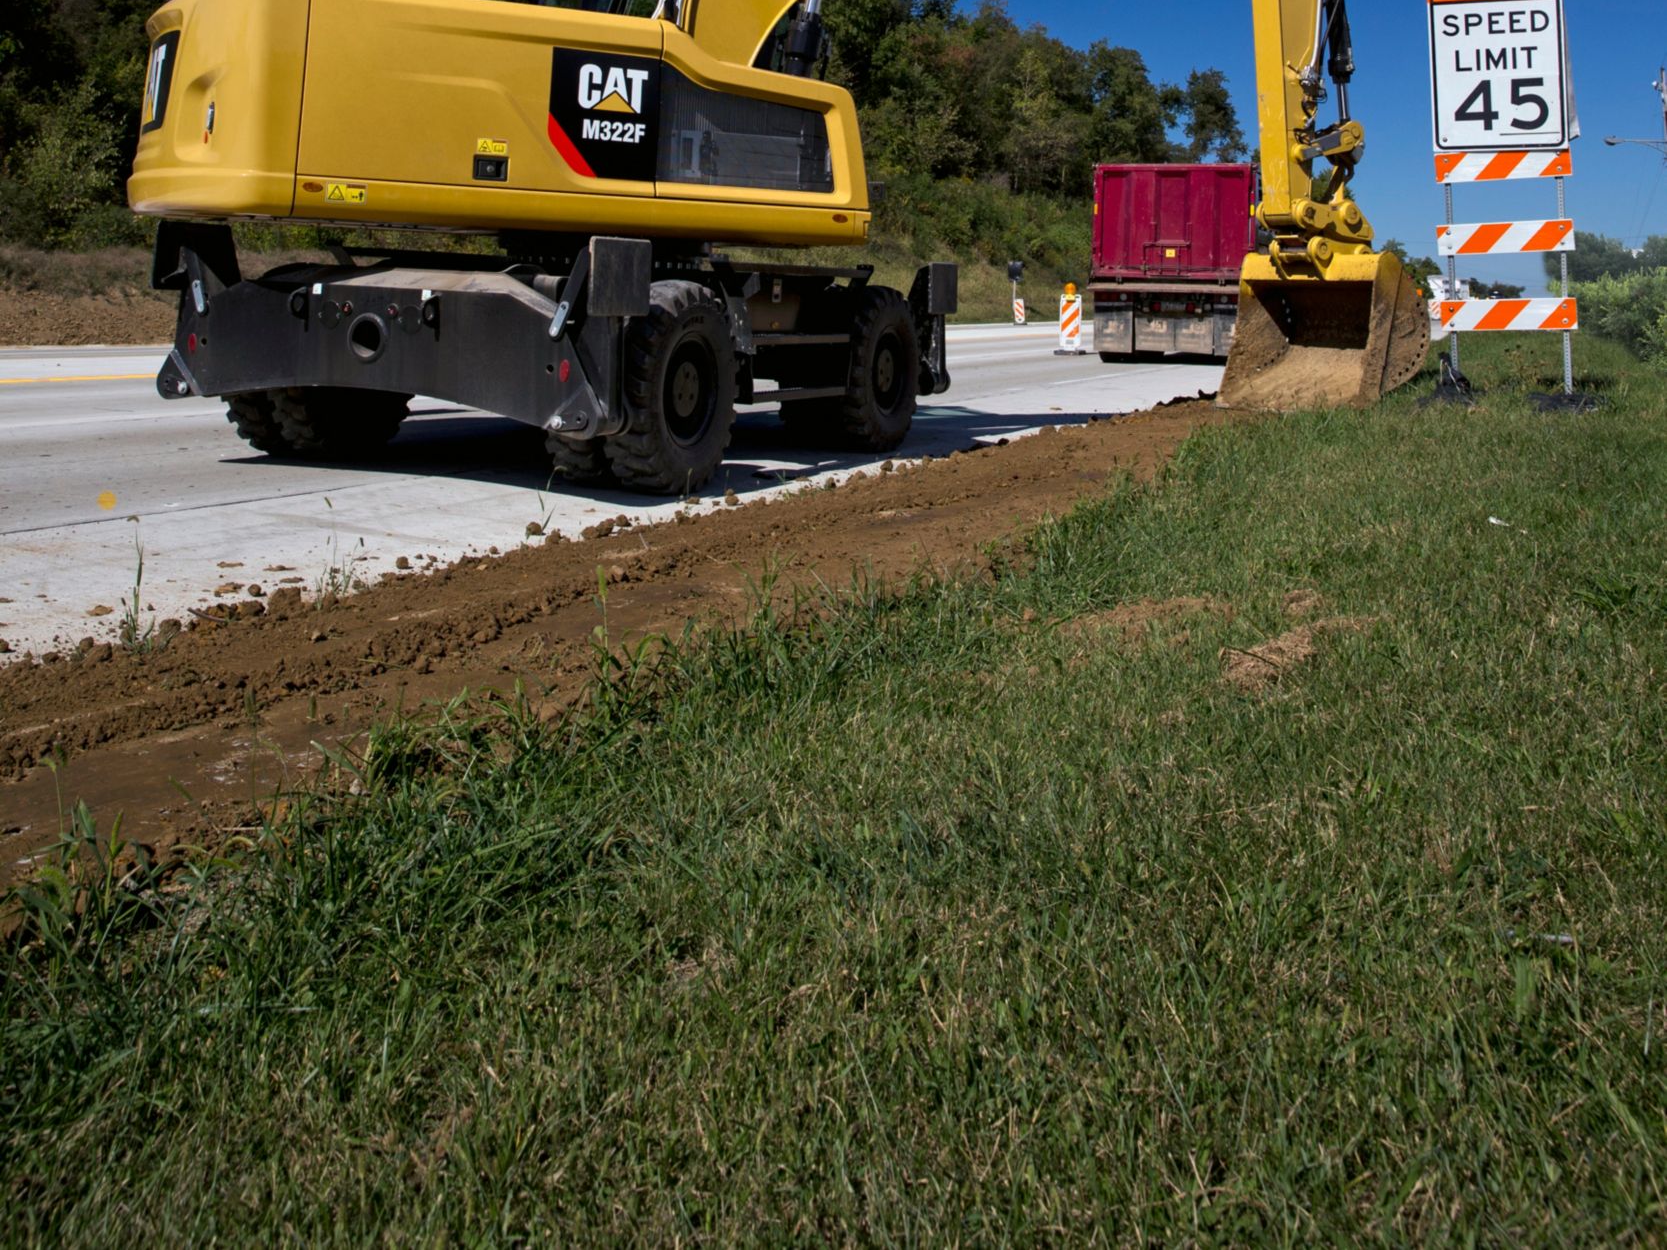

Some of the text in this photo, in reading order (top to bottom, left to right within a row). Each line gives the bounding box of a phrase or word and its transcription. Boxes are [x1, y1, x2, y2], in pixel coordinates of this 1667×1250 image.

[1442, 10, 1549, 37] SPEED
[1455, 46, 1538, 72] LIMIT
[577, 63, 649, 114] CAT
[1454, 77, 1549, 131] 45
[581, 118, 646, 144] M322F
